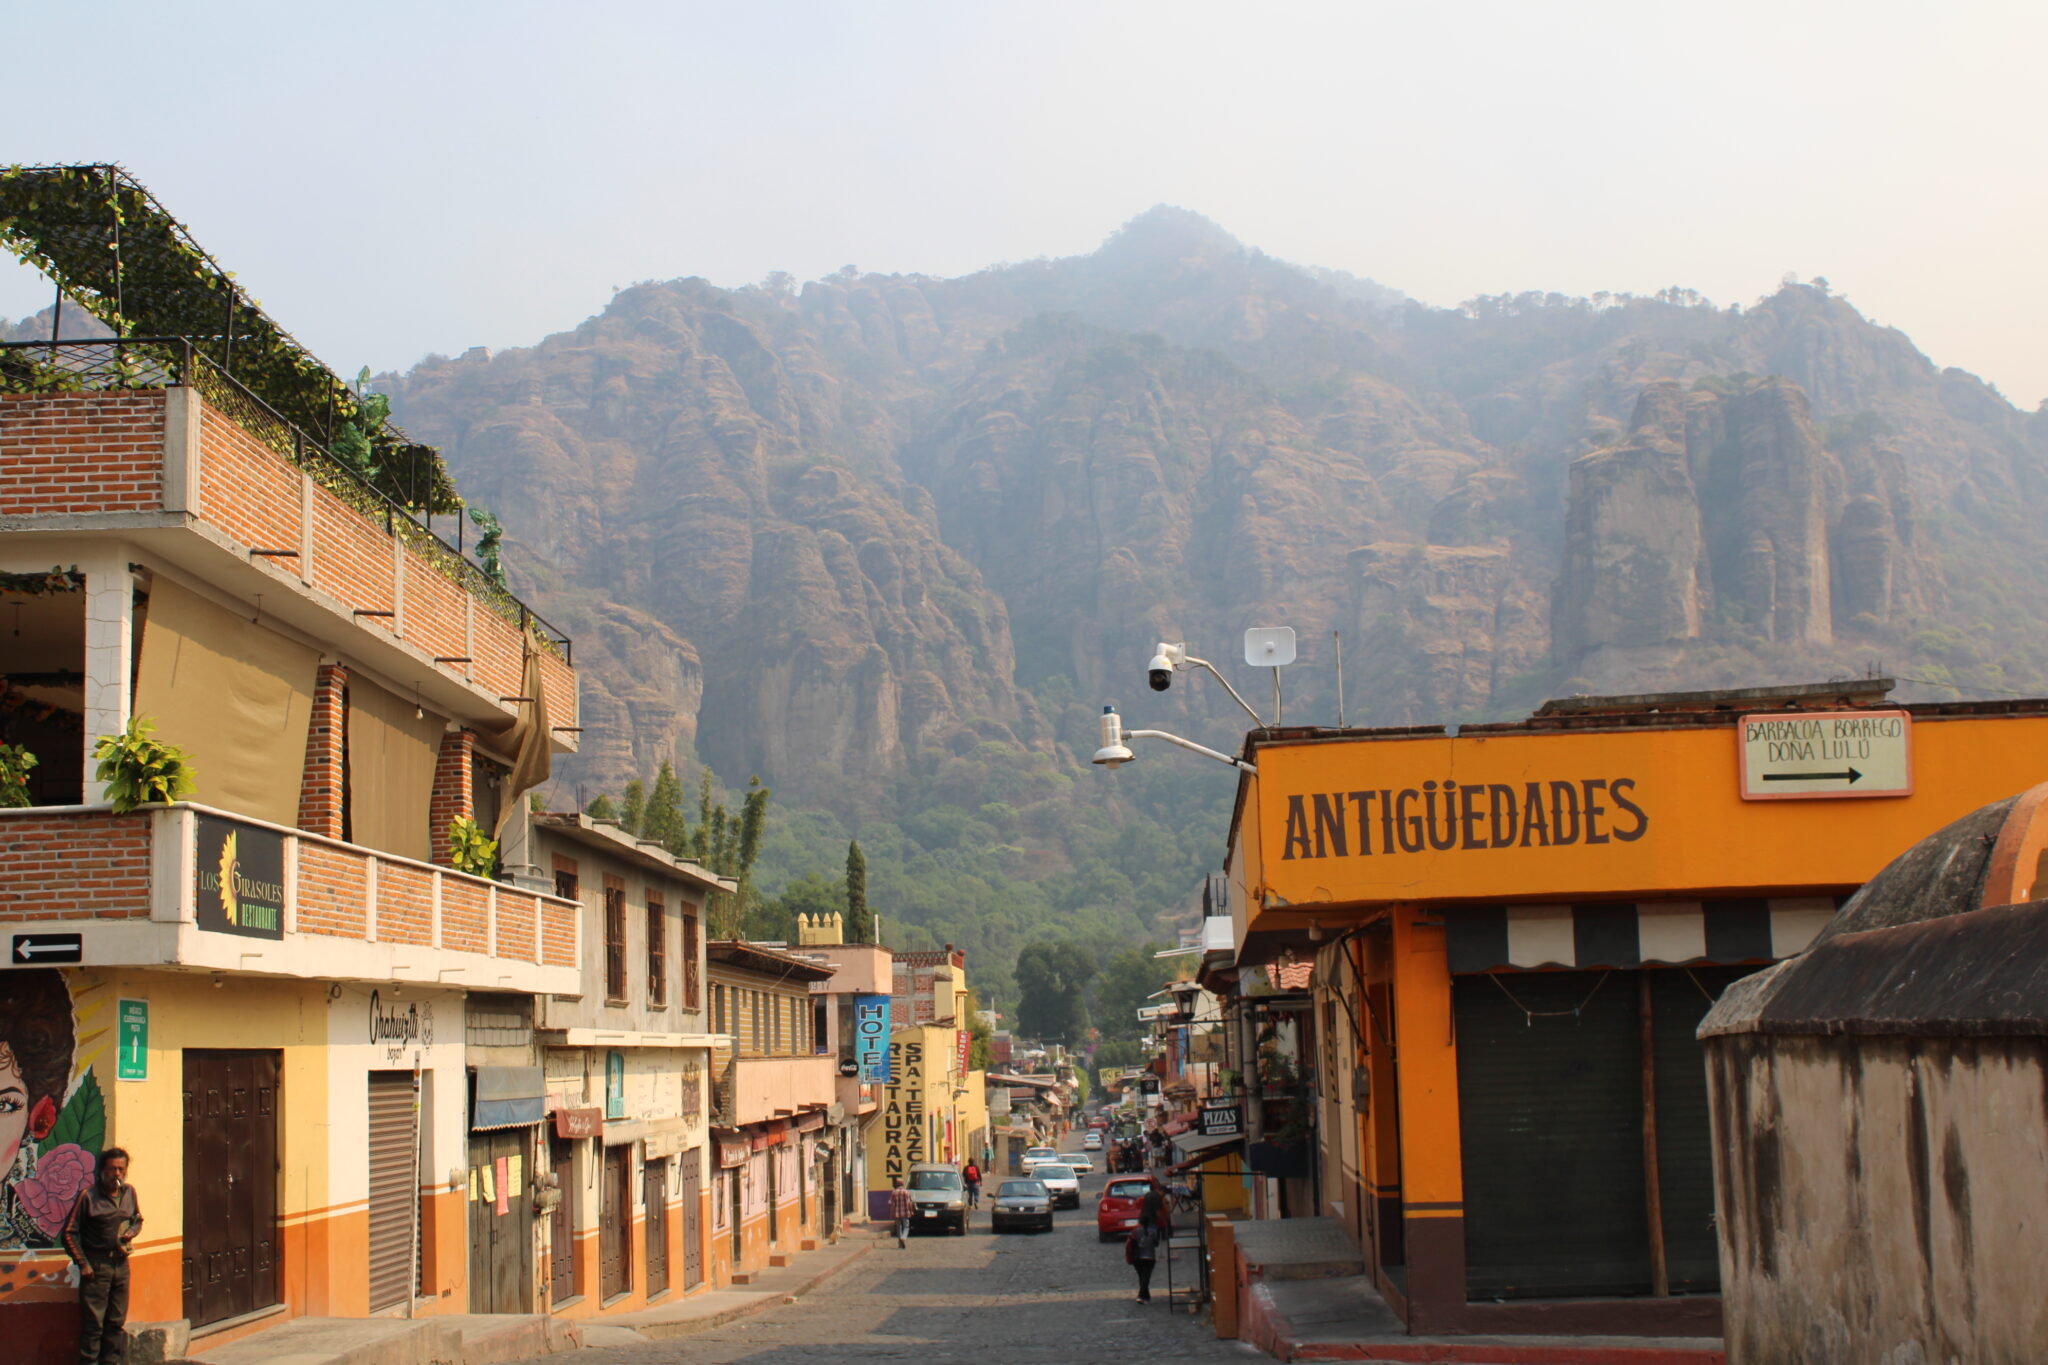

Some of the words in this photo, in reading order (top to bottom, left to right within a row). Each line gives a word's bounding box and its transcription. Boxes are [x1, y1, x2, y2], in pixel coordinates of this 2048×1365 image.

[1746, 720, 1824, 742] BARBACOA
[1834, 718, 1902, 739] BORREGO
[1821, 738, 1871, 760] LULÚ
[1281, 778, 1649, 860] ANTIGÜEDADES
[200, 870, 220, 892] LOS
[231, 860, 283, 904] GIRASOLES
[241, 902, 278, 931] RESTAURANTE
[859, 1004, 884, 1082] HOTEL
[905, 1042, 922, 1078] SPA
[884, 1041, 902, 1190] RESTAURANT
[1203, 1110, 1237, 1126] PIZZAS
